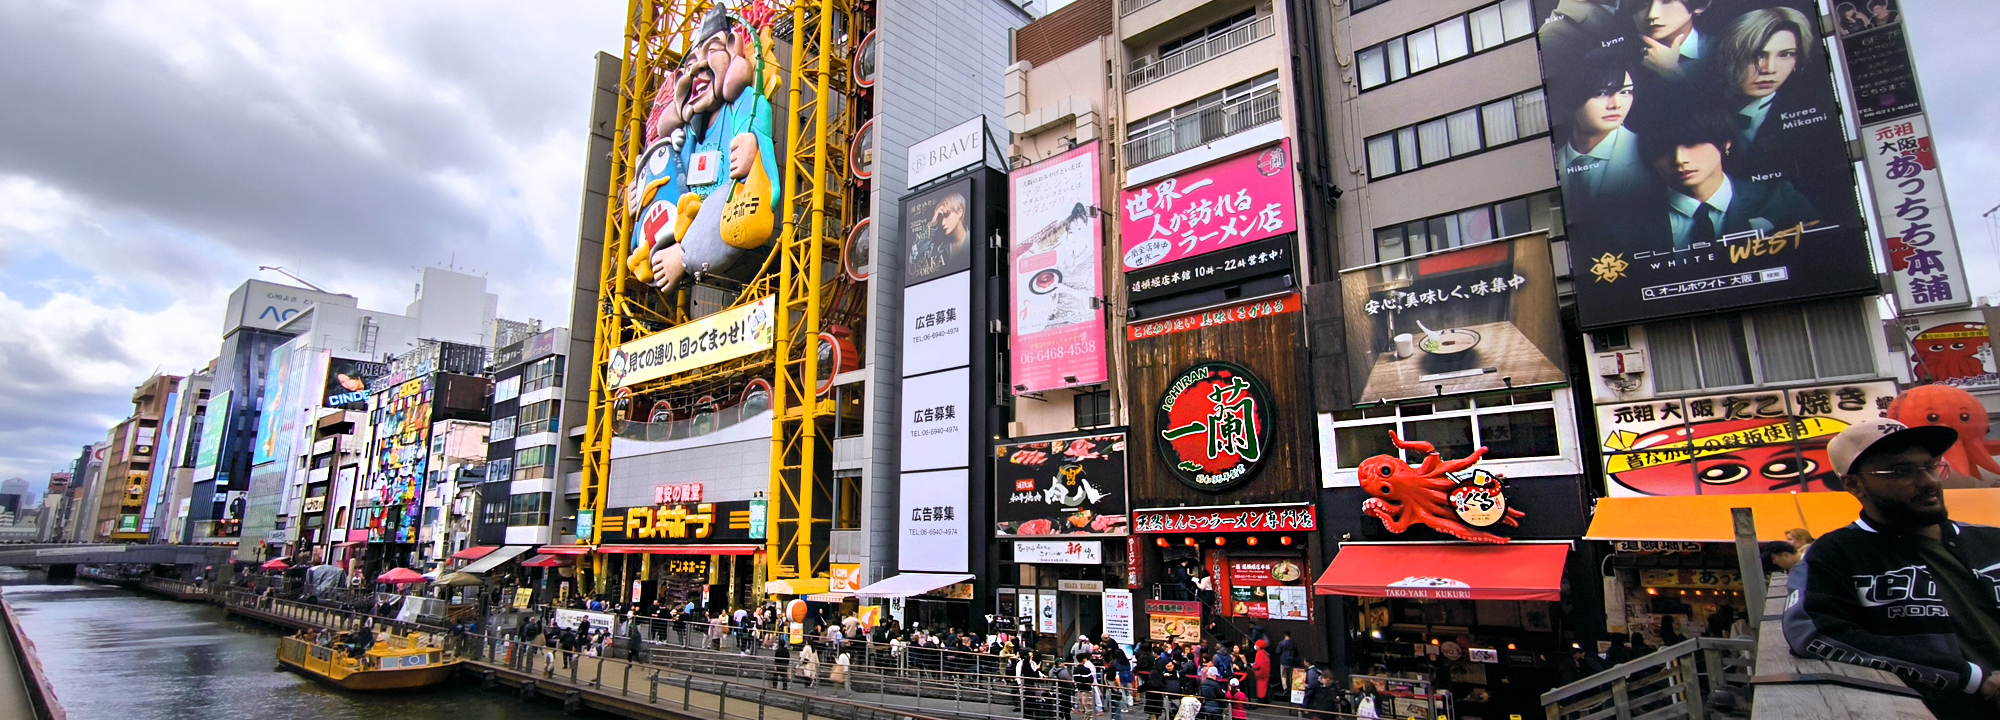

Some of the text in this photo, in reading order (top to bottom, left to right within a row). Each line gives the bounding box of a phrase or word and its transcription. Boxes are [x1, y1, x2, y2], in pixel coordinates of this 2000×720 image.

[1545, 14, 1565, 24] Riku
[1602, 36, 1624, 48] Lynn
[1781, 107, 1817, 120] Kurea
[1783, 113, 1828, 130] Mikami
[1876, 122, 1915, 141] 元祖
[929, 131, 979, 167] BRAVE
[1879, 136, 1918, 155] 大阪
[1567, 161, 1600, 174] Hikaru
[1752, 170, 1782, 183] Neru
[1125, 178, 1213, 222] 世界一
[1148, 188, 1252, 240] 人が訪れる
[1178, 203, 1284, 255] ラーメン店
[1634, 240, 1711, 259] CLUB
[1651, 220, 1820, 270] WHITE WEST
[1364, 273, 1526, 316] 安心、美味しく、味集中
[1658, 273, 1754, 296] オールホワイト 大阪
[915, 307, 957, 330] 広告募集
[1020, 340, 1096, 365] 06-6468-4538
[1162, 367, 1208, 412] ICHIRAN
[913, 404, 956, 425] 広告募集
[1162, 376, 1260, 462] 一蘭
[911, 506, 954, 522] 広告募集
[1135, 509, 1314, 531] 天然とんこつラーメン専門店
[1385, 589, 1471, 598] TAKO-YAKI KUKURU
